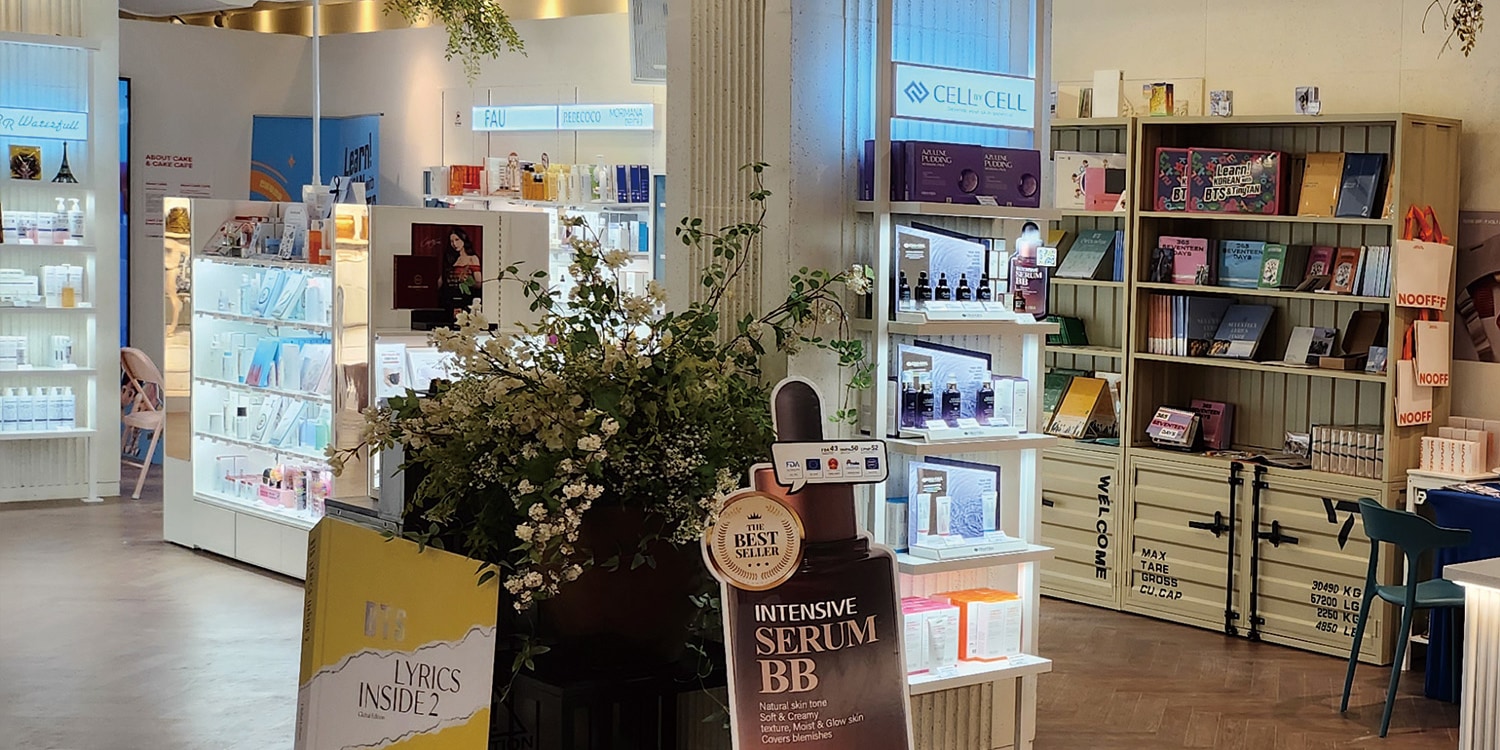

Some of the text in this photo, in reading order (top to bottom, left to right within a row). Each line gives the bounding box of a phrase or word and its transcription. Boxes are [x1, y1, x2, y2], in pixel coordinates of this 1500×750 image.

[933, 84, 978, 106] CELL
[984, 91, 1027, 111] CELL
[484, 109, 506, 128] FAU
[344, 132, 372, 177] Learn!
[921, 155, 952, 164] PUDDING
[984, 160, 1013, 169] PUDDING
[1217, 161, 1251, 177] Learn!
[1213, 177, 1241, 186] KOREAN
[1205, 187, 1225, 202] BTS
[1361, 206, 1369, 217] 2
[1162, 244, 1204, 252] SEVENTEEN
[1016, 271, 1042, 279] SERUM
[1016, 278, 1029, 287] BB
[1420, 373, 1448, 385] NOOFF
[1152, 420, 1185, 430] SEVENTEEN
[1400, 411, 1431, 425] NOOFF
[1161, 429, 1177, 437] DAYS
[1095, 475, 1111, 580] WELCOME
[734, 531, 779, 548] BEST
[736, 546, 779, 559] SELLER
[1142, 548, 1167, 561] MAX
[1141, 560, 1169, 575] TARE
[1141, 572, 1178, 587] GROSS
[1140, 584, 1183, 601] CU.CAP
[1343, 586, 1362, 598] KG
[755, 597, 858, 622] INTENSIVE
[1315, 621, 1338, 633] 4850
[755, 614, 880, 656] SERUM
[394, 659, 461, 694] LYRICS
[756, 658, 819, 694] BB
[358, 682, 440, 717] INSIDE 2
[759, 699, 827, 711] Natural skin tone
[760, 711, 819, 721] Soft & Creamy
[761, 713, 864, 733] texture, Moist & Glow skin
[761, 730, 833, 744] Covers blemishes
